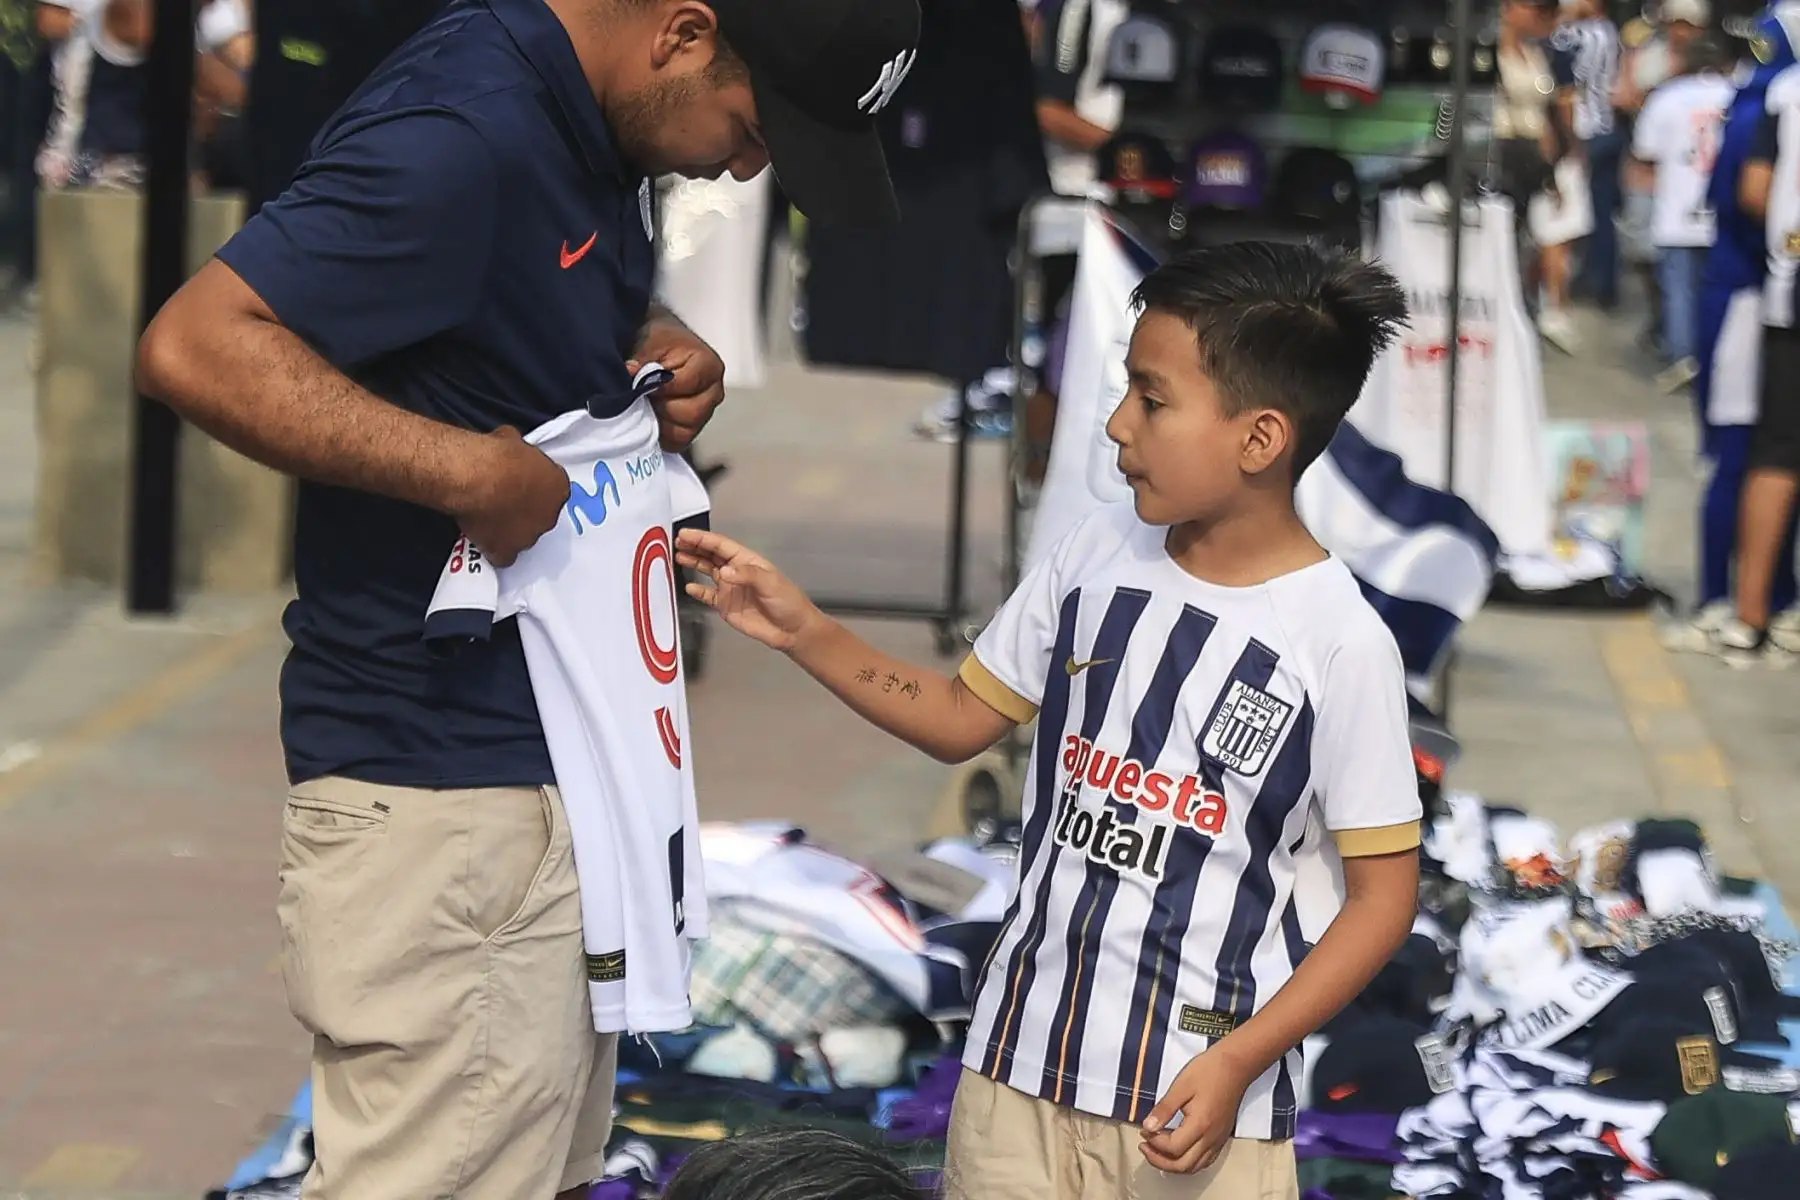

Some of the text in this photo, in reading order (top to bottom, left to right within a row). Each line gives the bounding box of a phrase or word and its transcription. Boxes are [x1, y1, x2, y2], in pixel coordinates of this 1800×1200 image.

[449, 533, 464, 574] TO
[468, 543, 482, 574] AS
[1236, 684, 1283, 714] ALIANZA
[1213, 702, 1233, 733] CLUB
[1255, 726, 1281, 753] LIMA
[1216, 750, 1243, 769] 1901
[1063, 735, 1228, 835] apuesta
[1056, 794, 1167, 878] total
